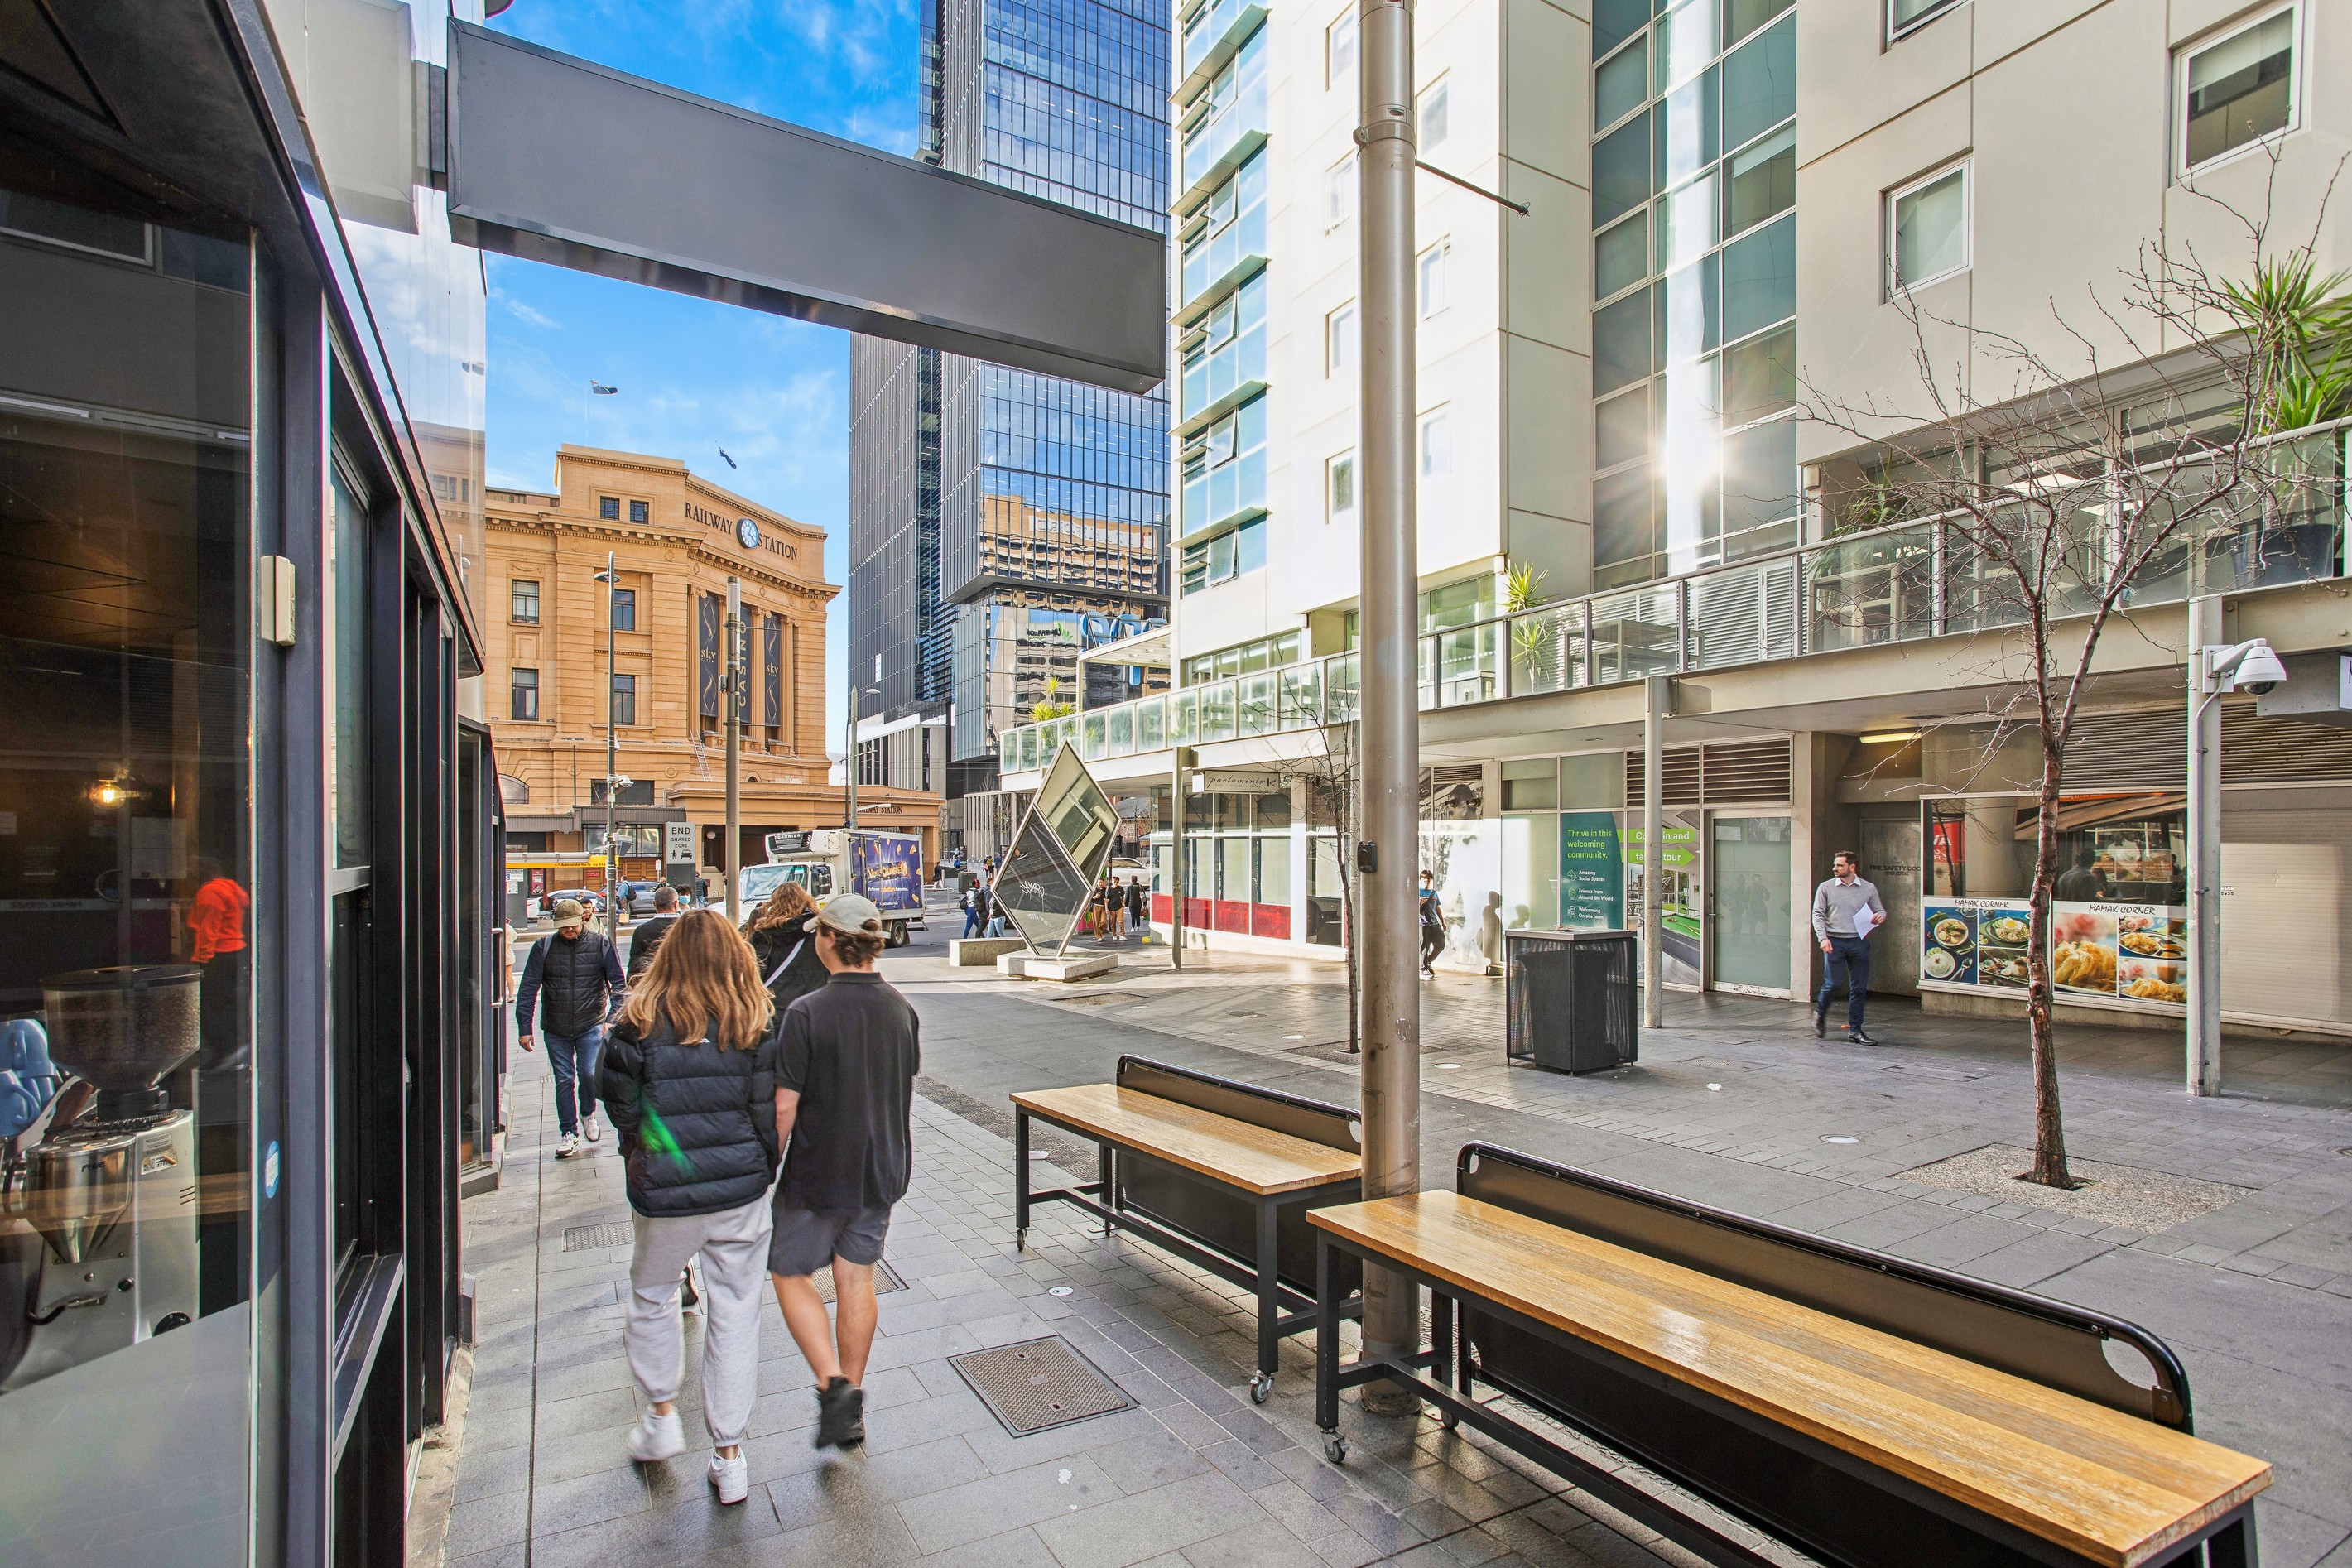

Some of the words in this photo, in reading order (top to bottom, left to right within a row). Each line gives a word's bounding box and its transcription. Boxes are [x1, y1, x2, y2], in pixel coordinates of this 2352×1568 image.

[685, 502, 733, 535] RAILWAY
[758, 533, 797, 560] STATION
[1207, 775, 1266, 788] parlamento
[1567, 829, 1589, 837] Thrive
[1590, 829, 1598, 837] in
[1599, 829, 1612, 837] this
[1662, 831, 1671, 839] in
[1672, 831, 1690, 839] and
[1567, 840, 1605, 849] welcoming
[1567, 851, 1608, 860] community.
[1663, 853, 1681, 861] tour
[1979, 900, 2009, 908] CORNER
[2089, 904, 2119, 913] MAMAK
[2120, 906, 2155, 915] CORNER
